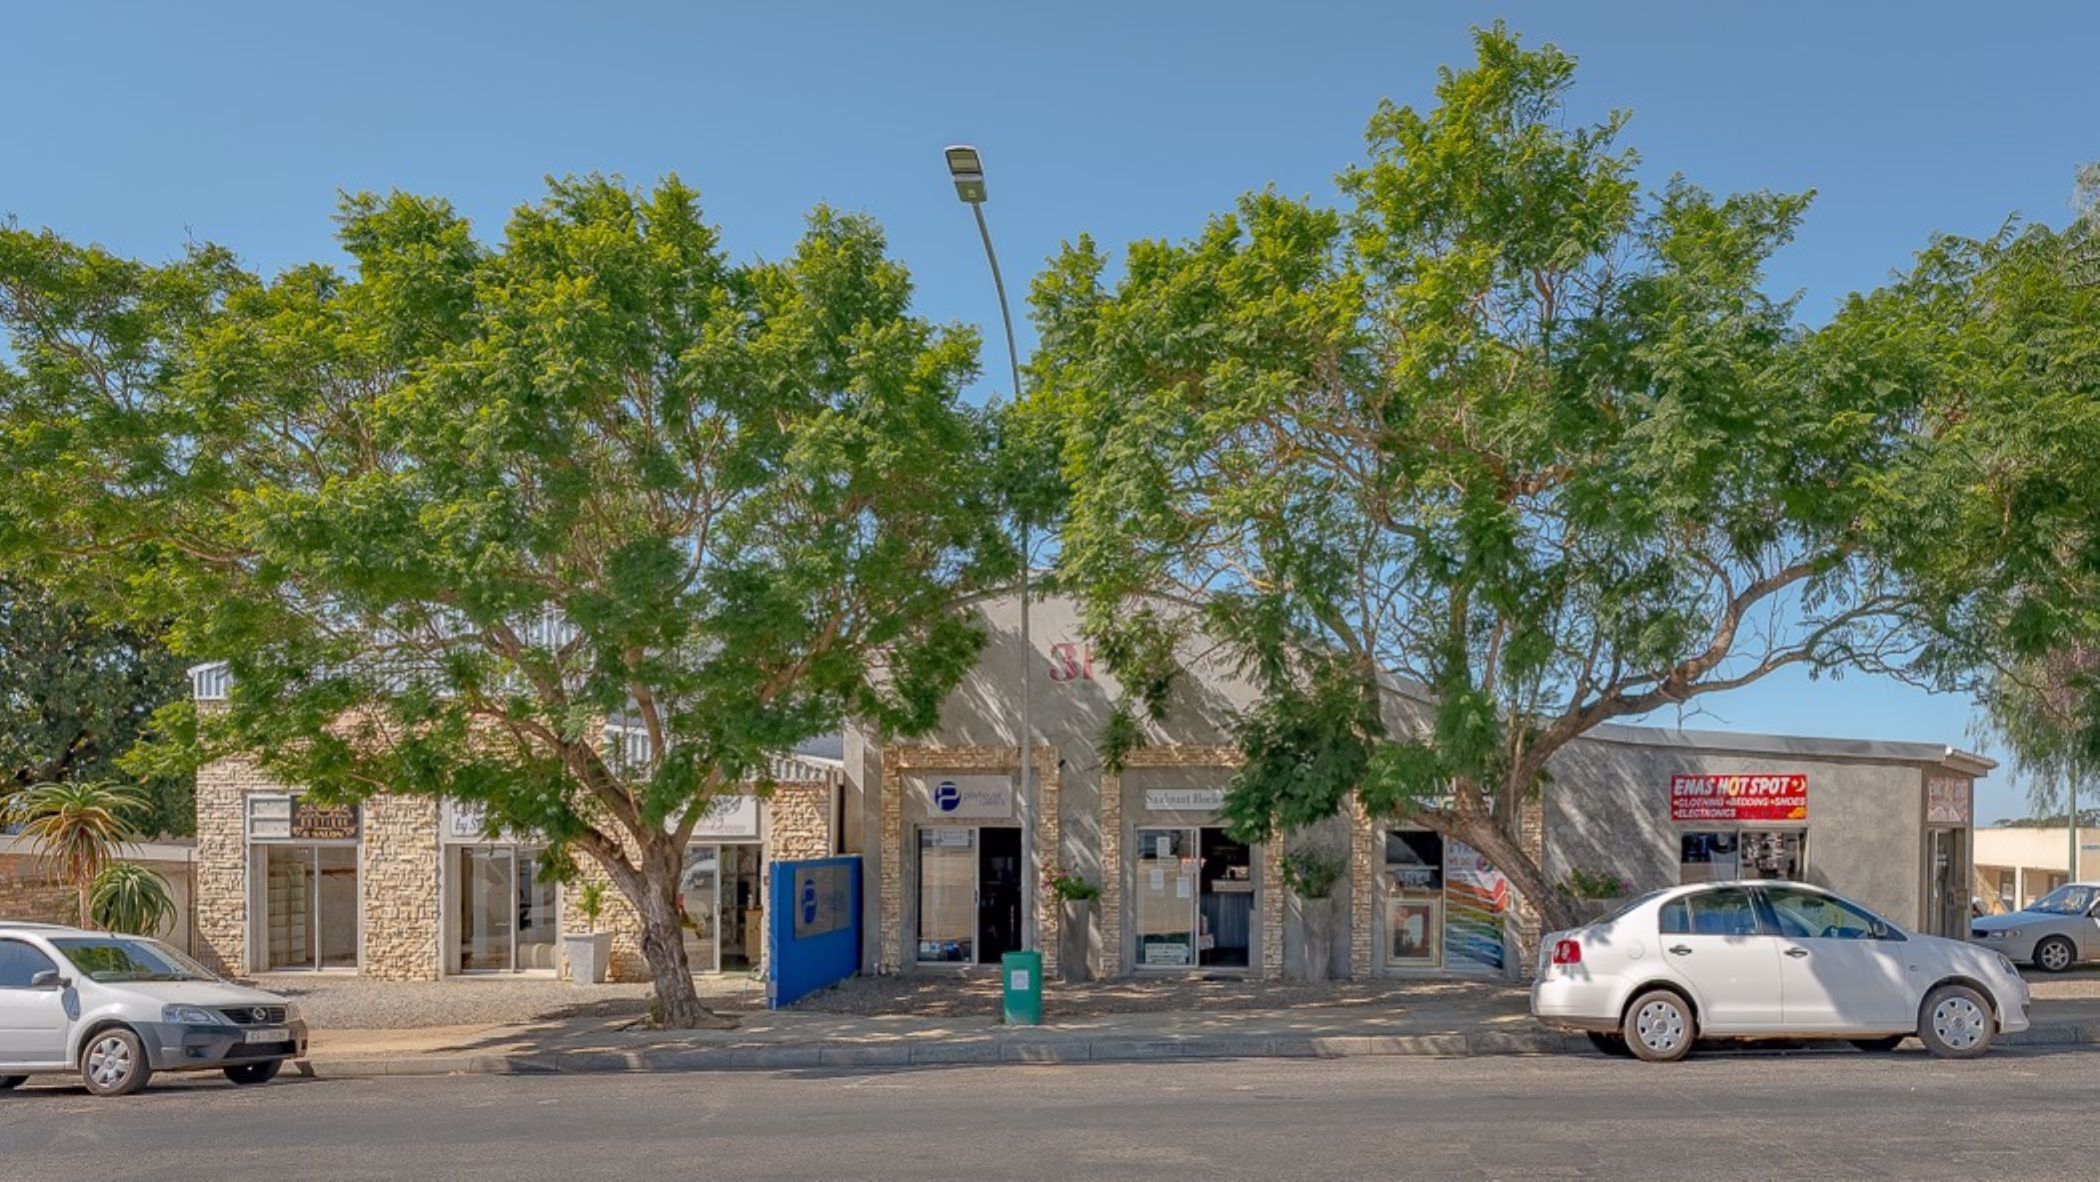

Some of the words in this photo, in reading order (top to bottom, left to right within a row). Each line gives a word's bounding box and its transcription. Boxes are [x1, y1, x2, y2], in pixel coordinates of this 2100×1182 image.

[1717, 777, 1749, 796] HOT
[1748, 777, 1790, 795] SPOT
[1774, 796, 1807, 806] SHOES
[1678, 808, 1737, 818] ELECTRONICS
